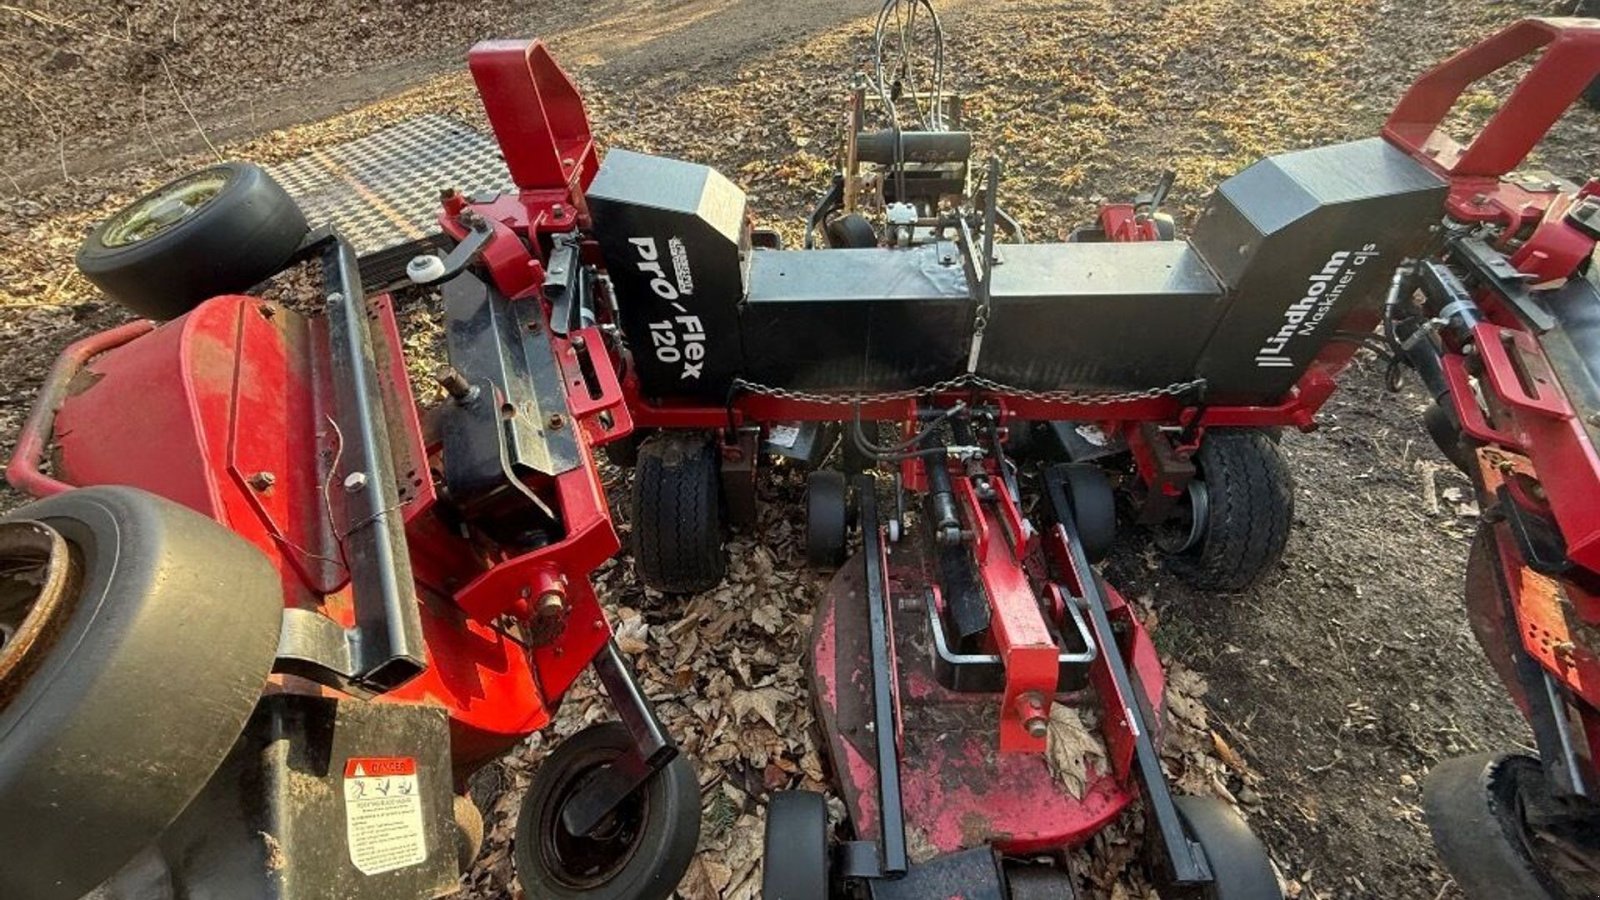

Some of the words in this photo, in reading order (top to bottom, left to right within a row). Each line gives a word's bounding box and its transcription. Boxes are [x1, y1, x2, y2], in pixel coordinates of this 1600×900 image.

[1259, 251, 1351, 354] Lindholm
[1298, 269, 1357, 335] Maskiner
[648, 320, 681, 363] 120
